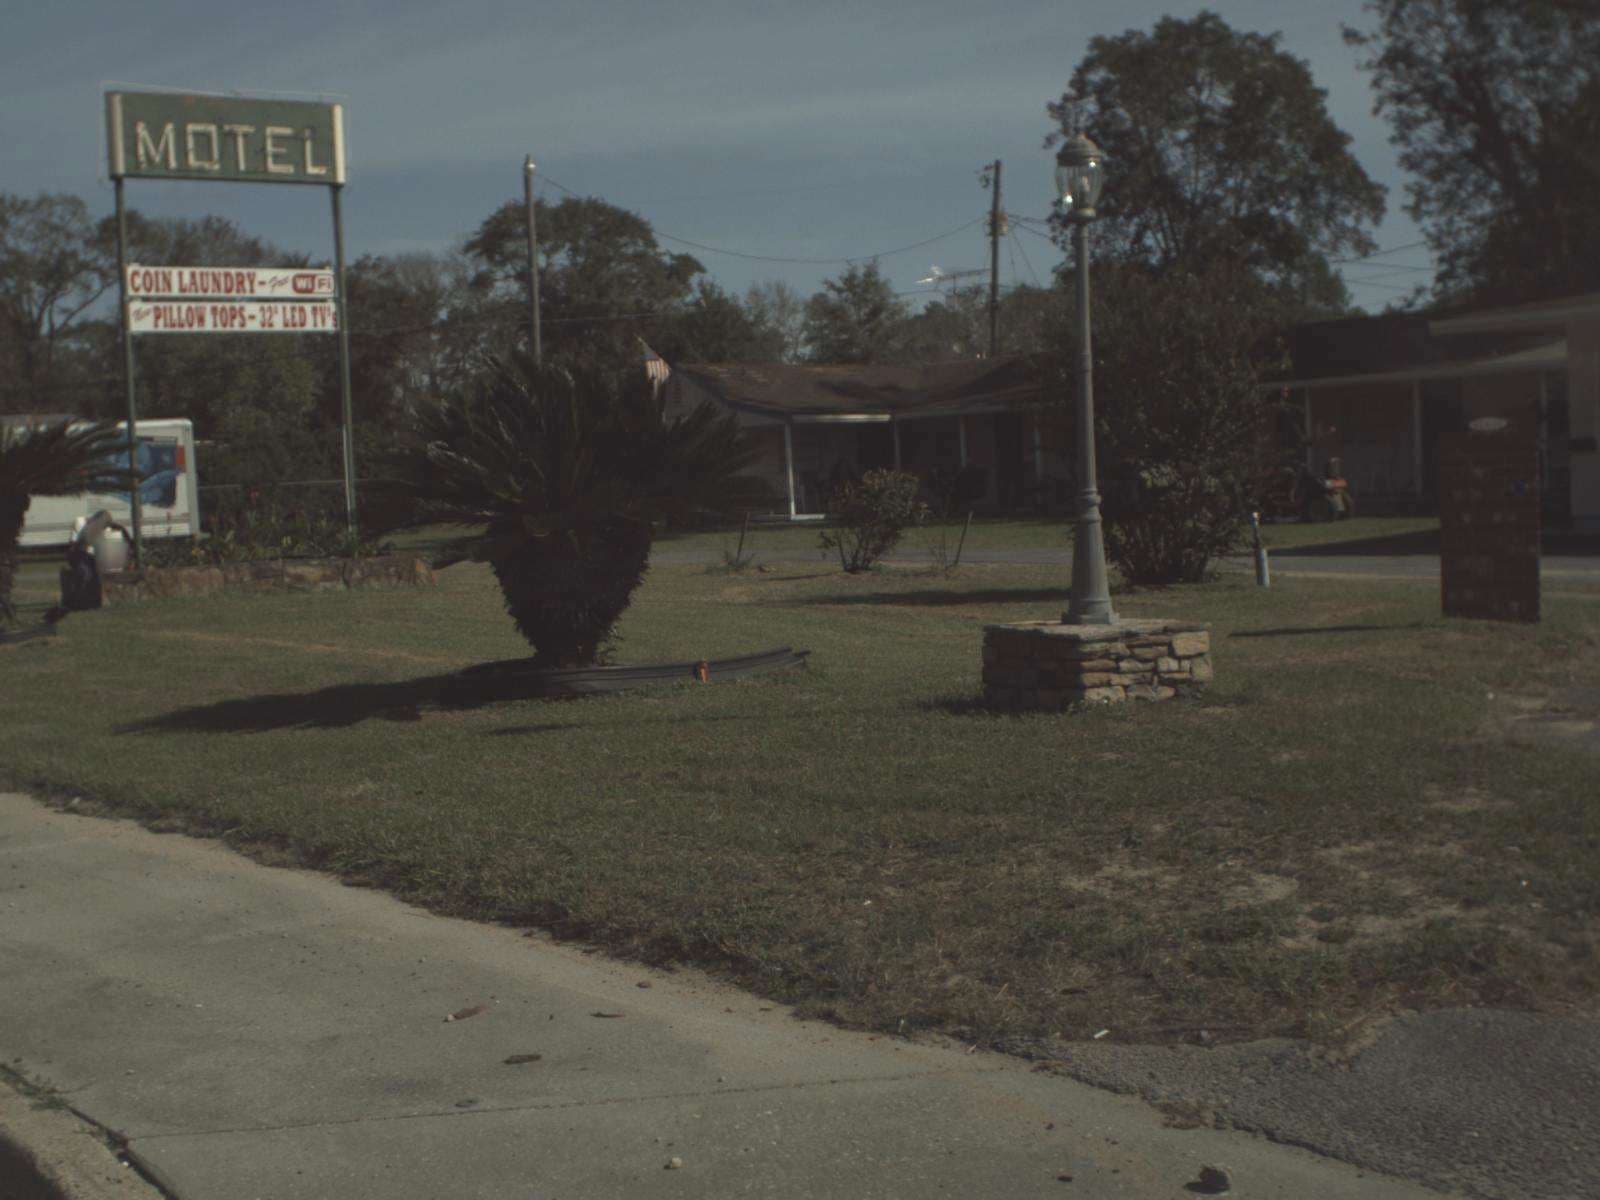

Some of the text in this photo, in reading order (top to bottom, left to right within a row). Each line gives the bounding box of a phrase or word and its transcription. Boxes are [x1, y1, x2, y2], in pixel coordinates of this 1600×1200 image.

[136, 121, 328, 175] MOTEL
[130, 270, 172, 293] COIN
[153, 306, 206, 328] PILLOW
[282, 306, 307, 328] LED
